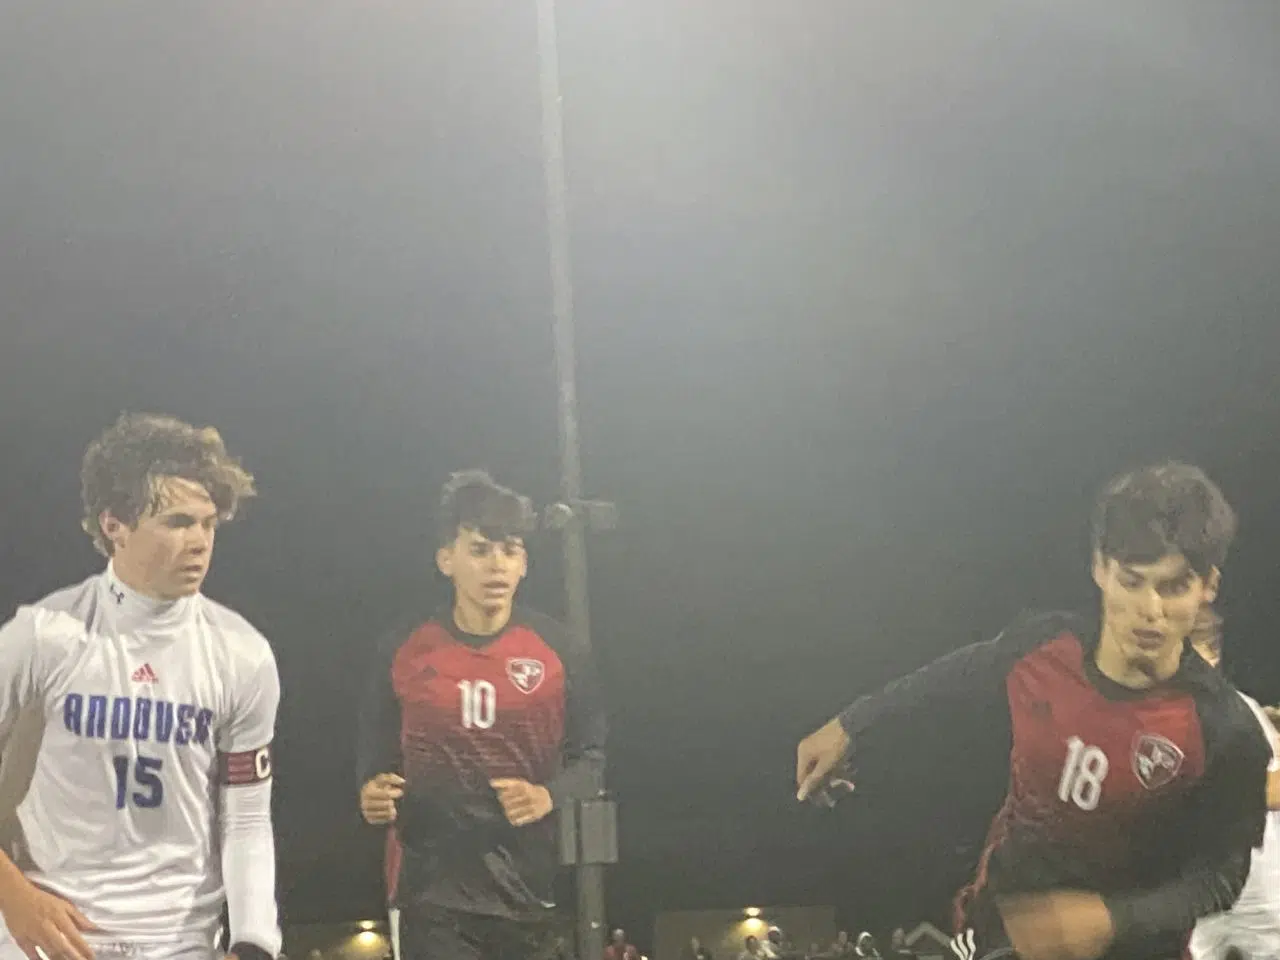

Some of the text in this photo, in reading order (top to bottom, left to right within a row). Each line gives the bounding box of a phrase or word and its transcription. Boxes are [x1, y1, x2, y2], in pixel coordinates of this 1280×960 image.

[457, 679, 496, 729] 10
[113, 755, 163, 809] 15
[255, 750, 271, 779] C
[1058, 736, 1108, 811] 18
